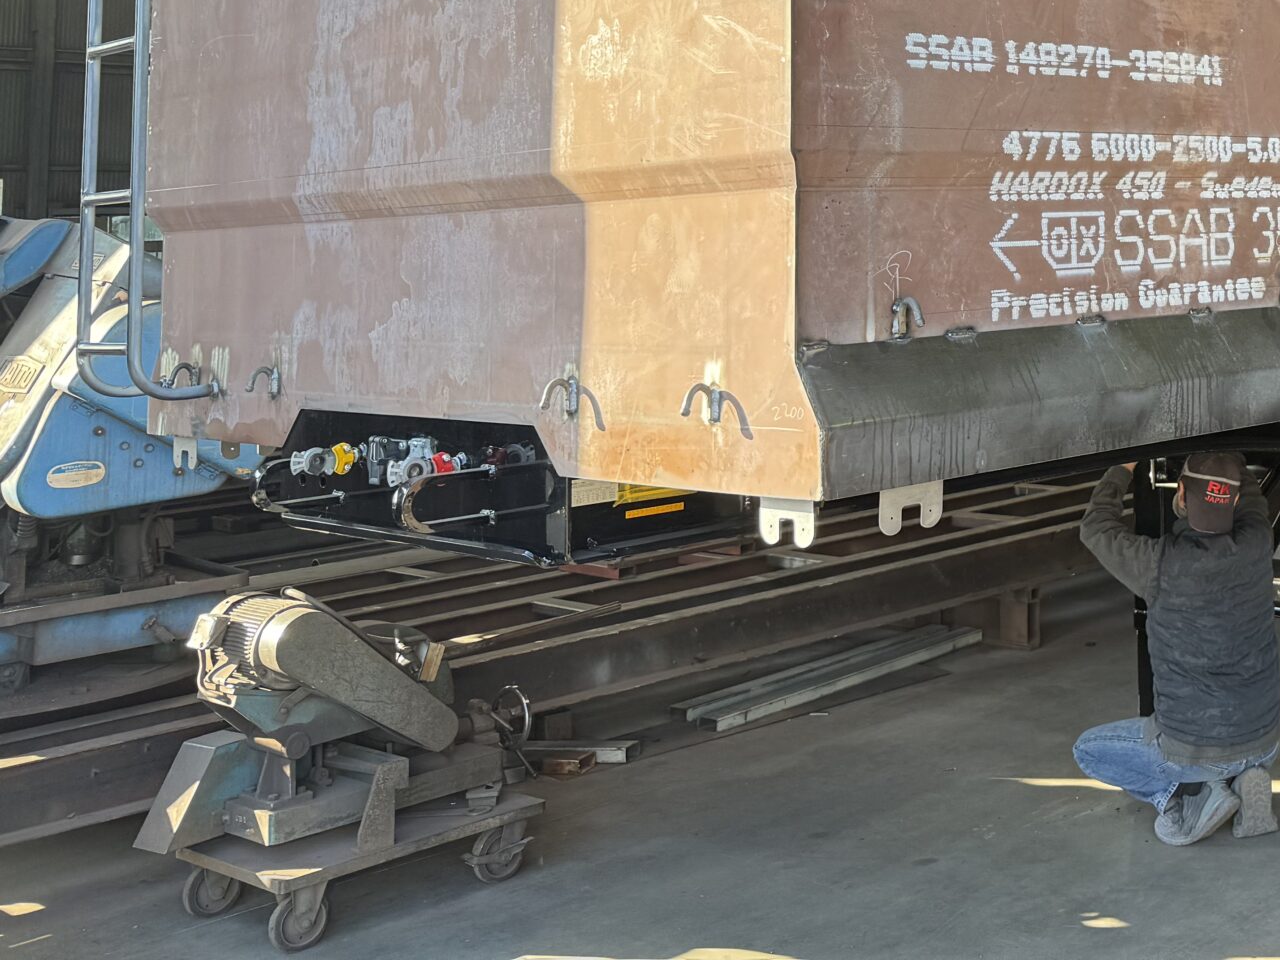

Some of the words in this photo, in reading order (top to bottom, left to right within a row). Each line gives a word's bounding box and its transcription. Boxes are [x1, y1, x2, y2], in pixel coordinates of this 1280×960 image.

[905, 33, 994, 73] SSAB
[1004, 40, 1223, 86] 148270-356841
[1002, 130, 1081, 161] 4776
[989, 171, 1108, 201] HARDOX
[1115, 170, 1167, 200] 450
[1114, 207, 1236, 271] SSAB
[990, 284, 1129, 322] Precision
[1138, 276, 1267, 309] Guarantee
[772, 402, 804, 420] 2200
[1206, 480, 1231, 494] RK
